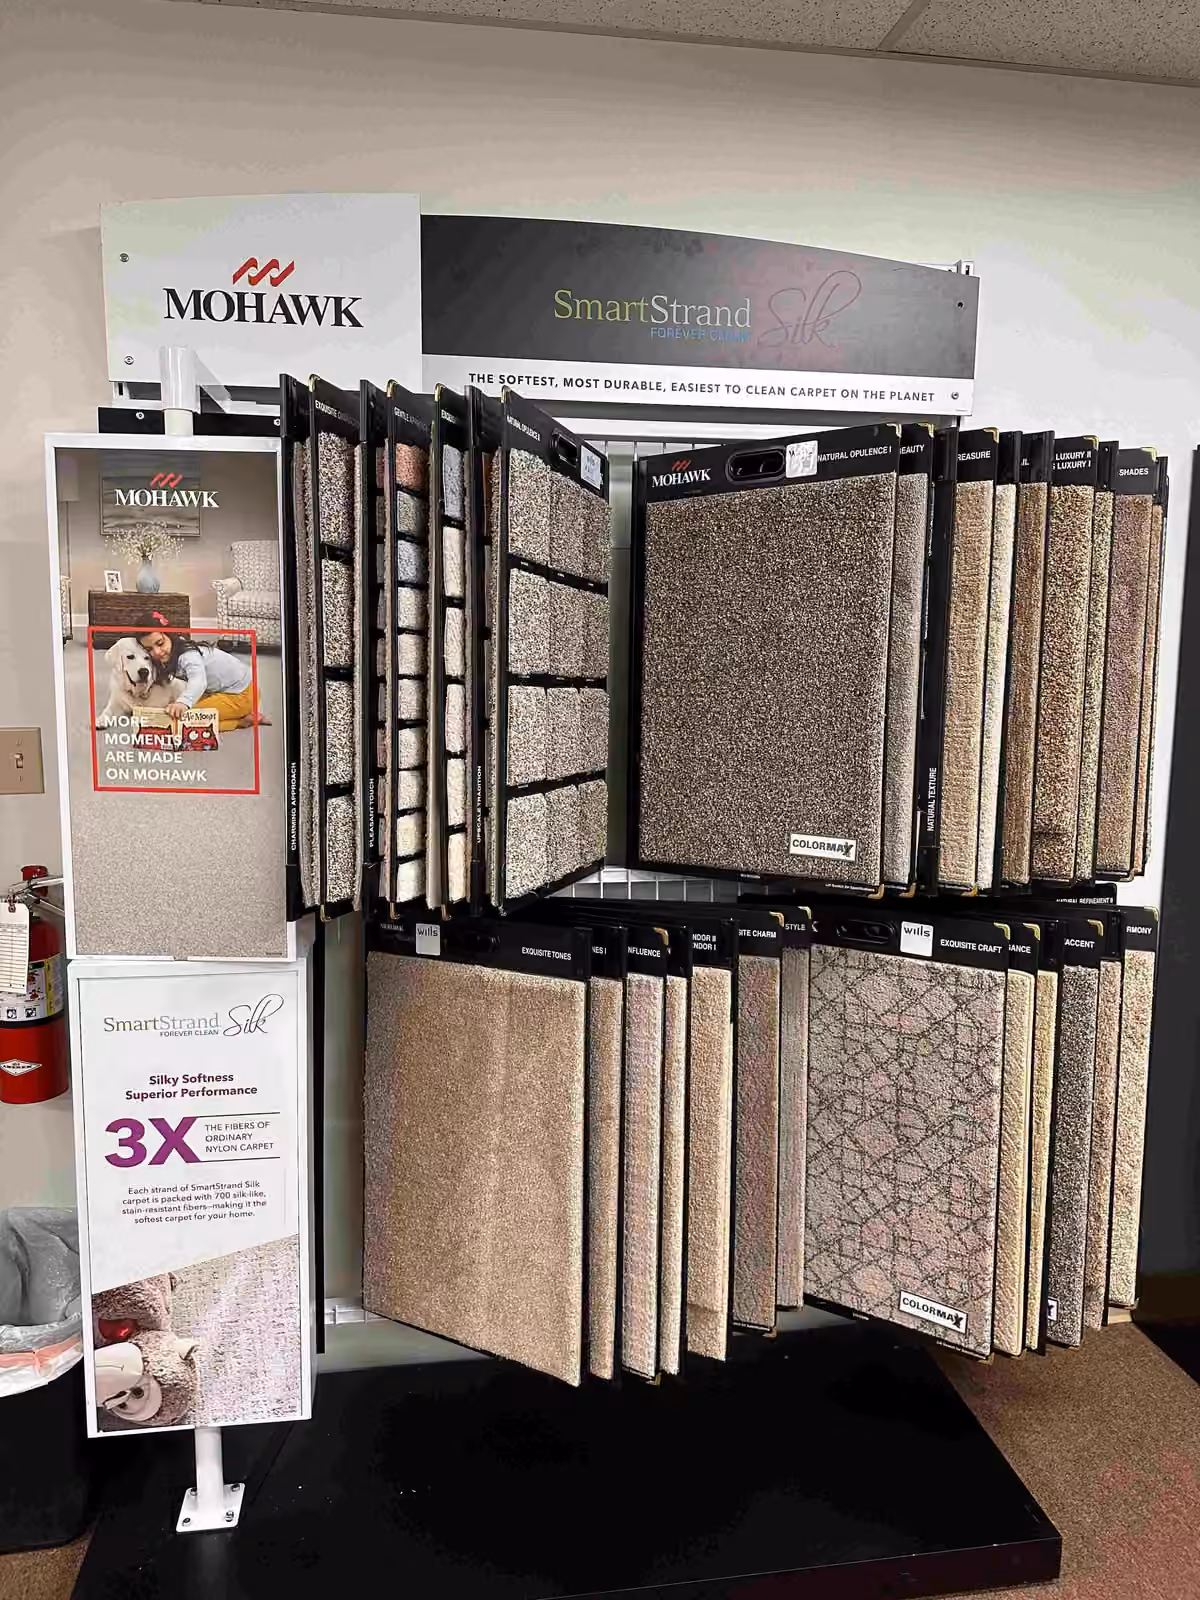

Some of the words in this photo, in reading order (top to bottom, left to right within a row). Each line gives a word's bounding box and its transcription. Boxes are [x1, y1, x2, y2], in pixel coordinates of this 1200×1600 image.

[162, 288, 364, 328] MOHAWK
[554, 289, 751, 328] SmartStrand
[757, 270, 862, 349] Silk
[650, 327, 706, 341] FOREVER
[469, 373, 494, 384] THE
[499, 374, 558, 388] SOFTEST,
[563, 377, 600, 389] MOST
[604, 379, 666, 392] DURABLE,
[671, 382, 721, 394] EASIEST
[725, 384, 741, 394] TO
[746, 385, 786, 396] CLEAN
[790, 387, 837, 398] CARPET
[841, 389, 859, 399] ON
[863, 390, 886, 400] THE
[890, 391, 935, 402] PLANET
[817, 452, 849, 463] NATURAL
[850, 447, 888, 459] OPULENCE
[1055, 451, 1085, 461] LUXURY
[1057, 460, 1087, 470] LUXURY
[1119, 467, 1149, 476] SHADES
[652, 468, 711, 488] MOHAWK
[114, 488, 220, 508] MOHAWK
[105, 715, 148, 728] MORE
[105, 733, 182, 746] MOMENTS
[105, 752, 135, 763] ARE
[138, 752, 183, 763] MADE
[106, 768, 130, 780] ON
[134, 769, 207, 782] MOHAWK
[928, 767, 937, 800] TEXTURE
[927, 800, 936, 832] NATURAL
[792, 839, 854, 858] COLORMAX
[417, 926, 439, 937] wills
[752, 930, 777, 938] CHARM
[785, 923, 806, 931] STYLE
[903, 925, 931, 937] wills
[521, 946, 551, 958] EXQUISITE
[551, 949, 572, 961] TONES
[940, 939, 977, 951] EXQUISITE
[978, 943, 1003, 954] CRAFT
[104, 1012, 220, 1033] SmartStrand
[223, 993, 285, 1037] Silk
[160, 1030, 193, 1038] FOREVER
[149, 1074, 179, 1087] Silky
[182, 1072, 235, 1084] Softness
[125, 1088, 178, 1102] Superior
[181, 1086, 258, 1098] Performance
[205, 1124, 223, 1132] THE
[225, 1122, 255, 1131] FIBERS
[257, 1121, 271, 1129] OF
[104, 1116, 201, 1168] 3X
[205, 1133, 253, 1143] ORDINARY
[205, 1144, 238, 1153] NYLON
[240, 1142, 274, 1152] CARPET
[128, 1185, 149, 1195] Each
[150, 1183, 178, 1194] strand
[179, 1183, 189, 1192] of
[191, 1181, 243, 1192] SmartStrand
[244, 1180, 260, 1189] Silk
[122, 1197, 150, 1207] carpet
[152, 1195, 159, 1204] is
[161, 1194, 192, 1205] packed
[194, 1193, 212, 1202] with
[215, 1192, 231, 1200] 700
[122, 1204, 181, 1216] stain-resistant
[245, 1200, 252, 1209] it
[253, 1199, 267, 1208] the
[134, 1214, 163, 1225] softest
[164, 1213, 192, 1224] carpet
[194, 1212, 206, 1221] for
[208, 1212, 227, 1222] your
[229, 1210, 255, 1220] home.
[902, 1297, 964, 1329] COLORMAX
